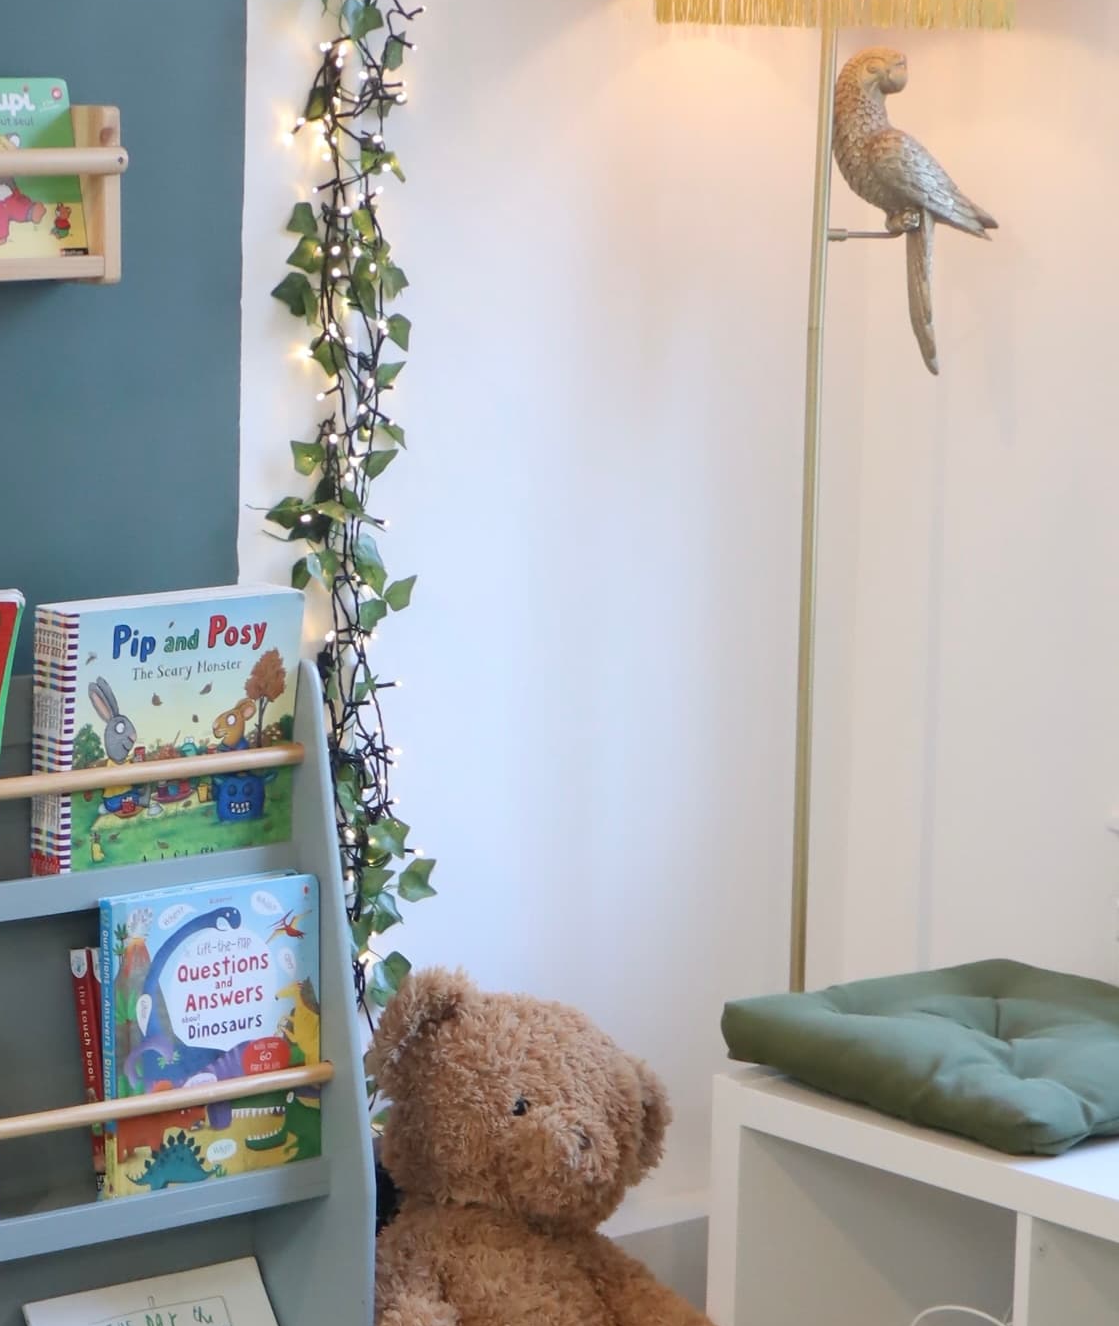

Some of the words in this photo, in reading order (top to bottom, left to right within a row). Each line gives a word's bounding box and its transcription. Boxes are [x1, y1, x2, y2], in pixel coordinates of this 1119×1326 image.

[13, 116, 35, 127] seul
[112, 623, 156, 663] Pip
[163, 628, 200, 653] and
[207, 614, 268, 651] Posy
[132, 667, 154, 682] The
[156, 661, 193, 682] Scary
[196, 659, 243, 673] Monster
[177, 952, 269, 983] Questions
[215, 976, 233, 990] and
[185, 985, 264, 1013] Answers
[81, 1010, 92, 1047] touch
[188, 1014, 263, 1040] Dinosaurs
[259, 1050, 273, 1062] 60
[192, 1305, 214, 1325] the
